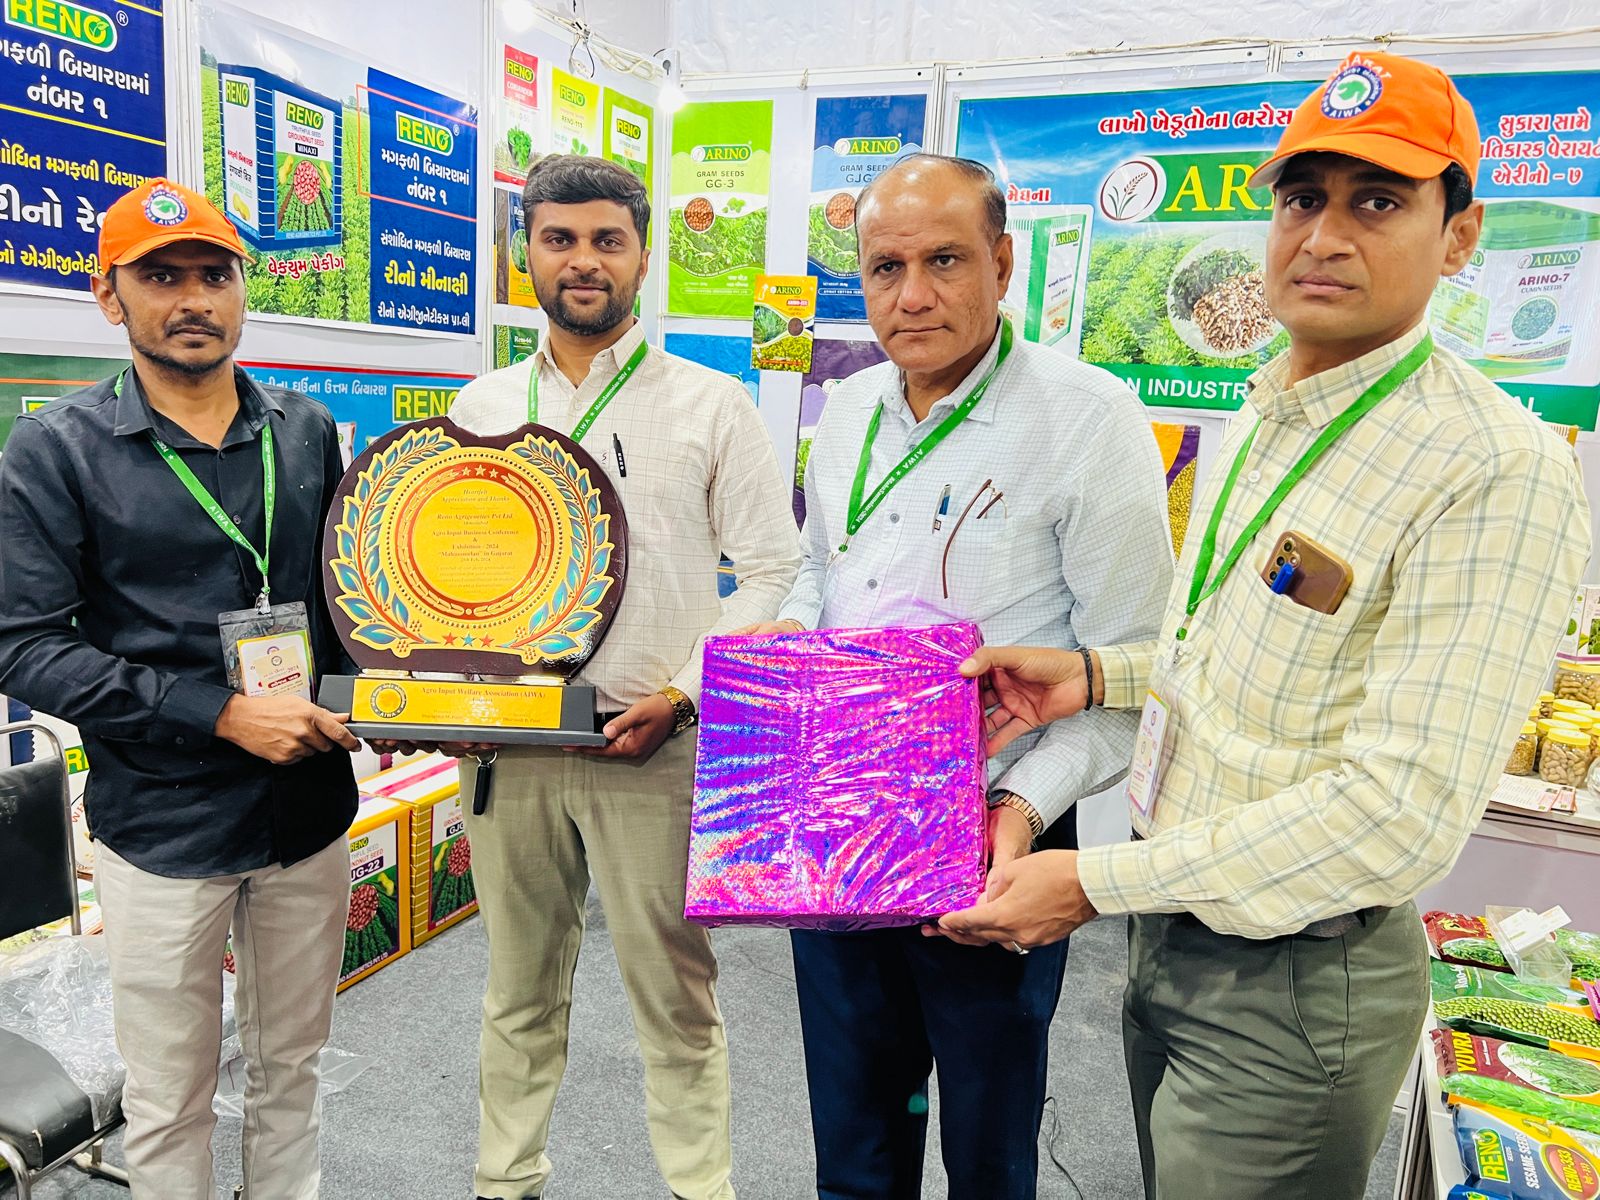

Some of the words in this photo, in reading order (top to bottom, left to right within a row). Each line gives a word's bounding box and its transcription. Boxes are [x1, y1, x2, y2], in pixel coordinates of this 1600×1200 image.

[9, 0, 109, 45] RENO
[0, 39, 51, 69] ગફળી
[59, 49, 149, 96] બિયારણમાં
[507, 61, 533, 81] RENO
[26, 74, 85, 114] નંબર
[226, 81, 249, 107] RENO
[560, 85, 585, 106] RENO
[287, 102, 323, 130] RENO
[1099, 110, 1147, 134] લાખો
[1152, 107, 1229, 137] ખેડૂતોના
[1329, 106, 1362, 118] AIWA
[1500, 114, 1549, 138] સુકારા
[1553, 107, 1590, 131] સામે
[288, 132, 314, 146] GROUNDNUT
[314, 137, 325, 147] SEED
[398, 119, 450, 151] RENO
[617, 119, 641, 139] RENO
[297, 145, 317, 156] MINAXI
[705, 147, 750, 161] ARINO
[850, 140, 899, 154] ARINO
[1480, 137, 1543, 160] તિકારક
[45, 156, 99, 181] મગફળી
[381, 148, 420, 172] મગફળી
[423, 156, 470, 186] બિયારણમાં
[1493, 163, 1549, 186] એરીનો
[407, 176, 436, 203] નંબર
[705, 179, 734, 188] GG-3
[1164, 164, 1275, 212] AR
[380, 229, 413, 250] સંશોધિત
[414, 238, 442, 256] મગફળી
[443, 243, 471, 262] બિયારણ
[1057, 229, 1079, 245] ARINO
[1532, 250, 1580, 267] ARINO
[384, 259, 416, 287] રીનો
[1518, 273, 1570, 286] ARINO-7
[776, 286, 801, 294] ARINO
[377, 301, 396, 319] રીનો
[325, 379, 348, 395] ઉત્તમ
[351, 380, 387, 396] બિયારણ
[575, 418, 591, 438] AIWA
[902, 448, 924, 469] AIWA
[209, 504, 230, 528] AIWA
[422, 687, 437, 695] Agro
[438, 687, 456, 696] Input
[457, 688, 481, 696] Welfare
[484, 690, 519, 698] Association
[520, 691, 546, 699] (AIWA)
[1479, 1131, 1506, 1180] RENO
[1520, 1154, 1540, 1190] SESAME
